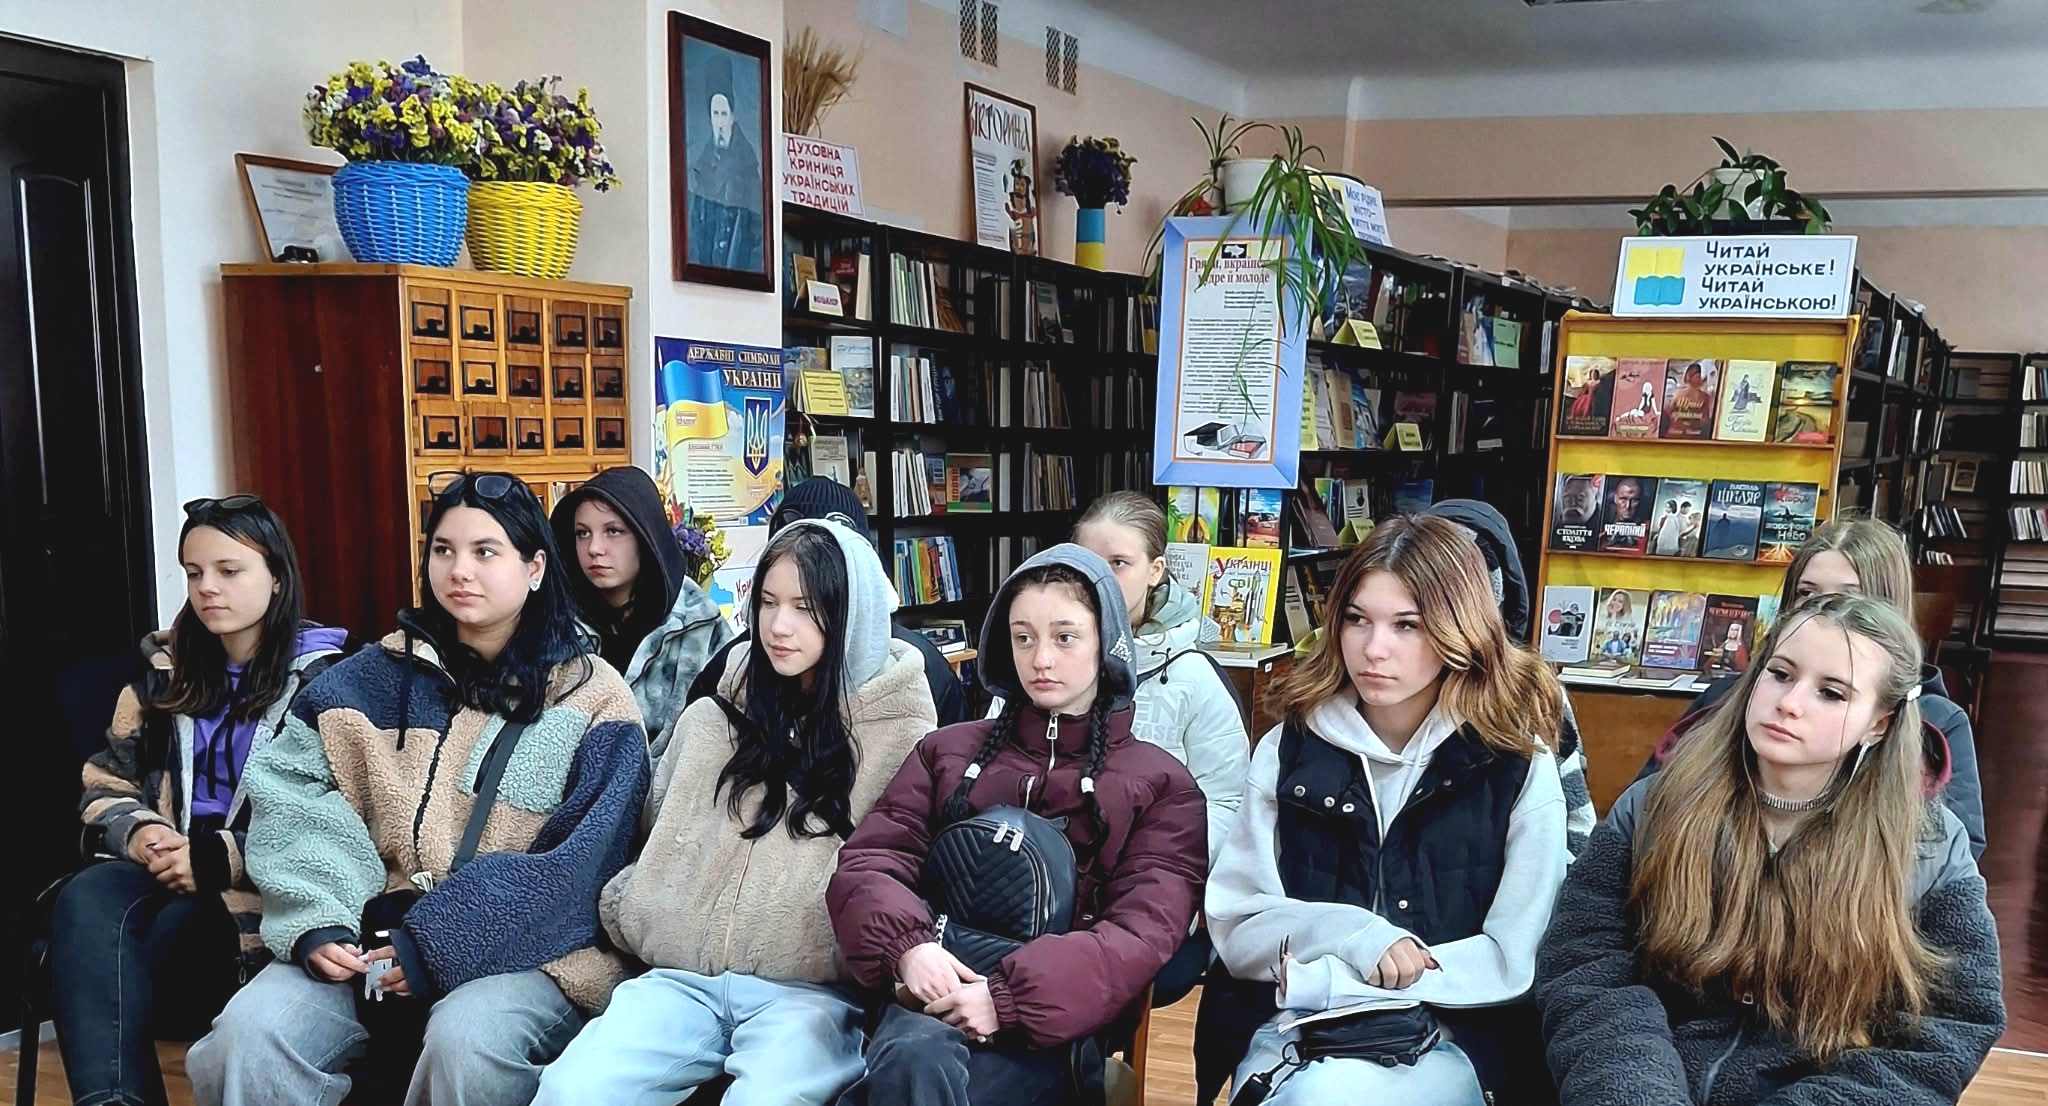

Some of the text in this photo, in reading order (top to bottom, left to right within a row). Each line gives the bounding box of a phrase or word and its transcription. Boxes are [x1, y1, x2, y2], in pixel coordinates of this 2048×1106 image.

[787, 136, 842, 161] ДУХОВНА
[789, 157, 845, 180] КРИНИЦЯ
[790, 189, 850, 213] ТРАДИЦІЙ
[1236, 272, 1270, 285] молоде
[688, 346, 735, 363] ДЕРЖАВНІ
[722, 368, 782, 390] УКРАЇНИ
